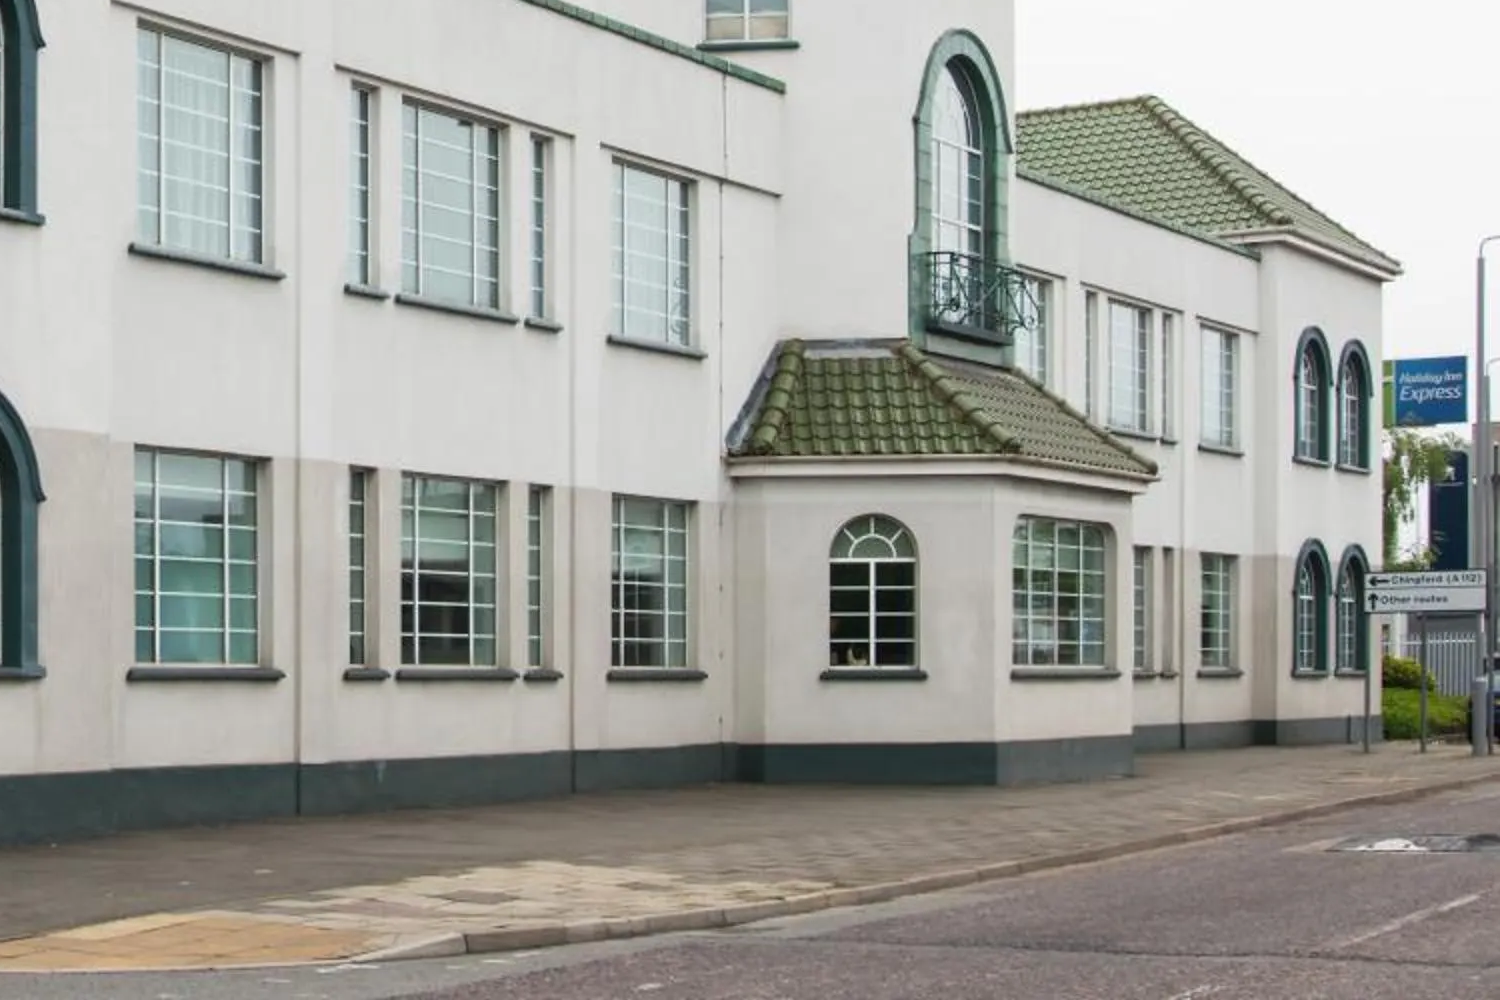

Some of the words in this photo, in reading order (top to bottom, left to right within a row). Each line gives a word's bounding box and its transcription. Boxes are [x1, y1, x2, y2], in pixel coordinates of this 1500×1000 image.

[1399, 371, 1443, 384] Holiday
[1443, 369, 1463, 381] Inn
[1400, 385, 1463, 404] Express
[1391, 574, 1443, 585] Chingford
[1381, 595, 1411, 605] Other
[1413, 594, 1449, 603] routes
